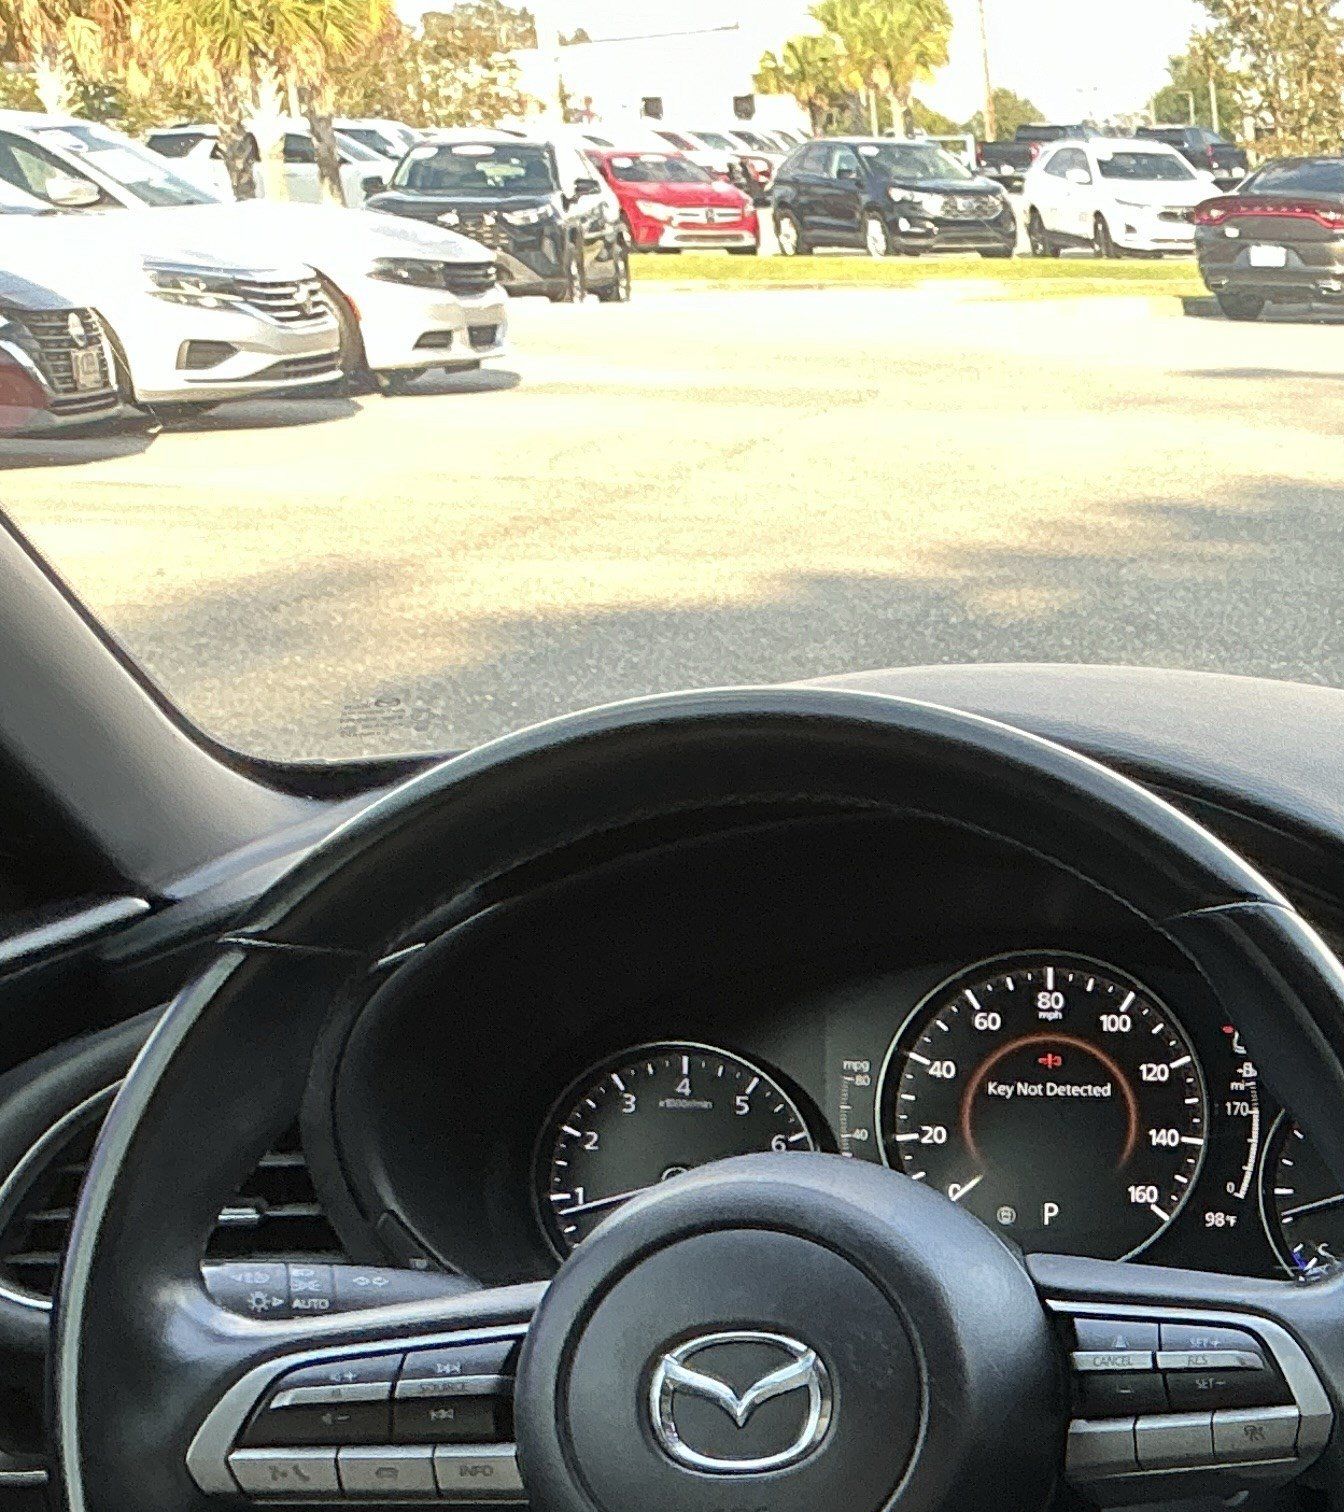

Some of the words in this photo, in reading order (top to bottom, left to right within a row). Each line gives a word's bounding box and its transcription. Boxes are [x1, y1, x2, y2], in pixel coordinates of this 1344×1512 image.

[1036, 991, 1064, 1011] 80
[974, 1012, 1001, 1031] 60
[1038, 1010, 1063, 1022] mph
[1099, 1013, 1132, 1033] 100
[842, 1060, 870, 1073] mpg
[929, 1060, 956, 1080] 40
[1139, 1062, 1170, 1082] 120
[675, 1078, 691, 1097] 4
[988, 1081, 1016, 1101] Key
[1017, 1081, 1044, 1097] Not
[1046, 1080, 1112, 1098] Detected
[622, 1093, 636, 1114] 3
[735, 1095, 750, 1116] 5
[1225, 1101, 1248, 1117] 170
[585, 1132, 600, 1151] 2
[853, 1127, 868, 1141] 40
[920, 1125, 947, 1144] 20
[1149, 1128, 1180, 1147] 140
[771, 1134, 787, 1154] 6
[574, 1186, 585, 1206] 1
[1128, 1184, 1159, 1204] 160
[1044, 1202, 1060, 1226] P
[292, 1297, 329, 1310] AUTO
[1093, 1354, 1134, 1367] CANCEL
[1187, 1354, 1208, 1366] RES
[459, 1463, 493, 1478] INFO
